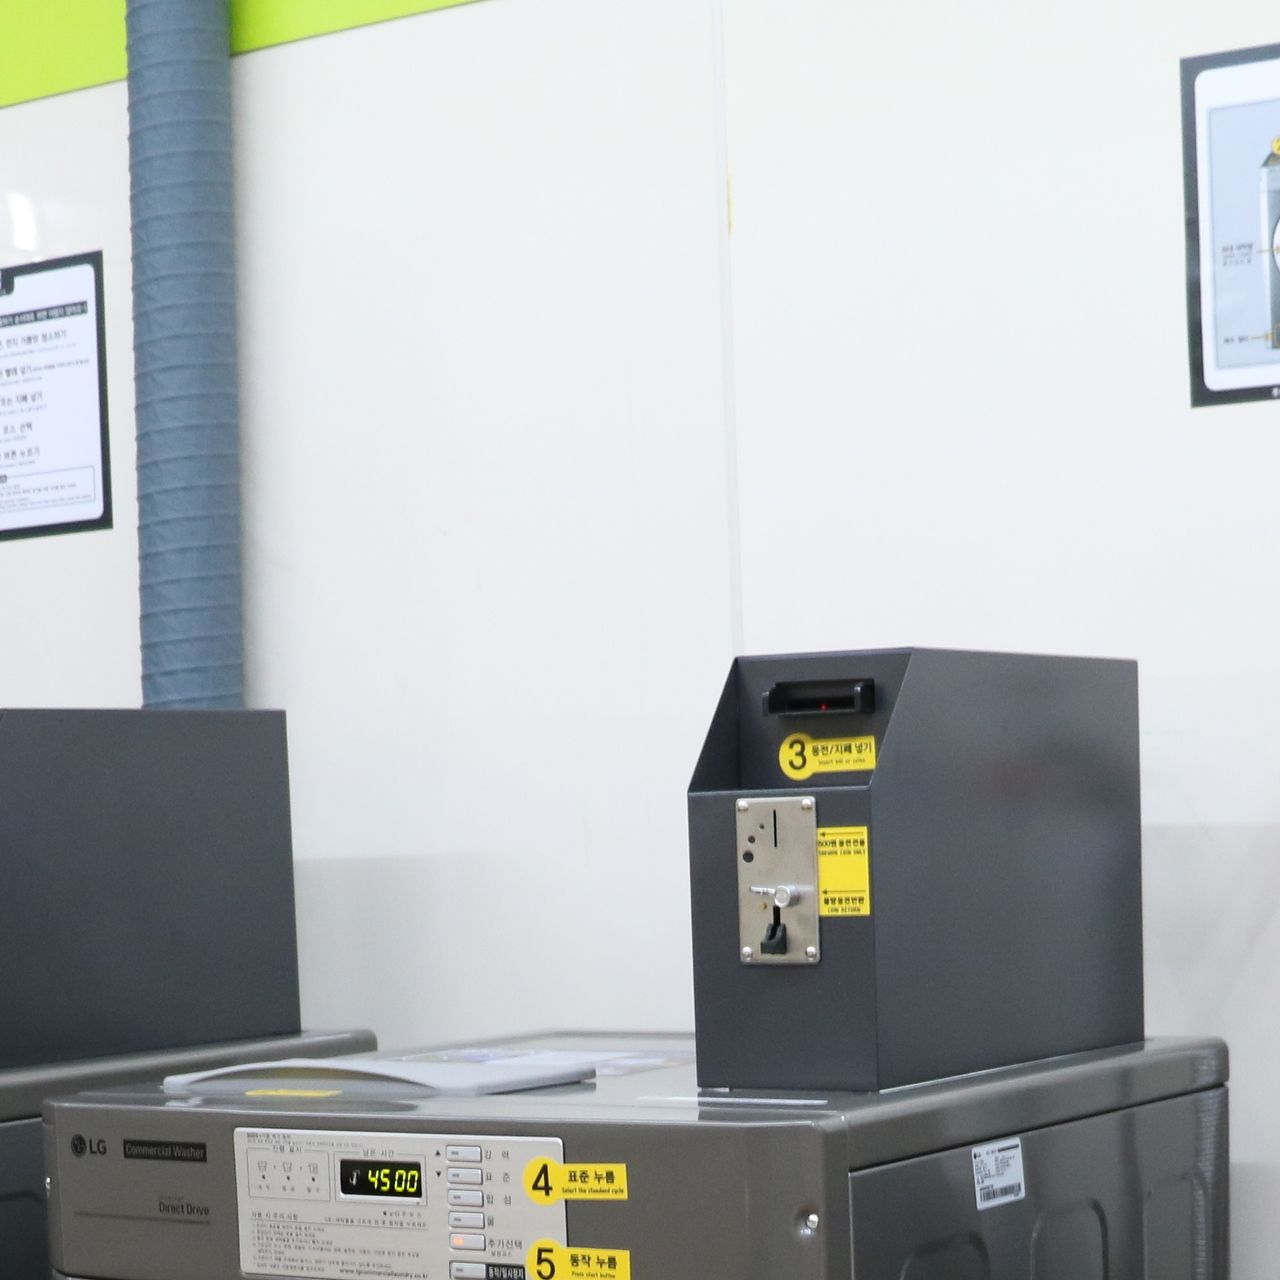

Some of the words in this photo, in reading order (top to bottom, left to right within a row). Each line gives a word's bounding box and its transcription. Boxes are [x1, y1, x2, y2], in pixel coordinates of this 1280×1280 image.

[789, 739, 807, 770] 3
[811, 744, 852, 757] 동전/지폐
[855, 742, 872, 755] 넣기
[126, 1144, 170, 1155] Commercial
[173, 1146, 206, 1158] Washer
[368, 1169, 418, 1192] 4500
[532, 1164, 553, 1196] 4
[568, 1171, 589, 1183] 표준
[594, 1170, 616, 1184] 누름
[159, 1201, 185, 1214] Direct
[186, 1204, 210, 1216] Drive
[536, 1248, 555, 1280] 5
[570, 1254, 590, 1266] 동작
[596, 1255, 617, 1269] 누름
